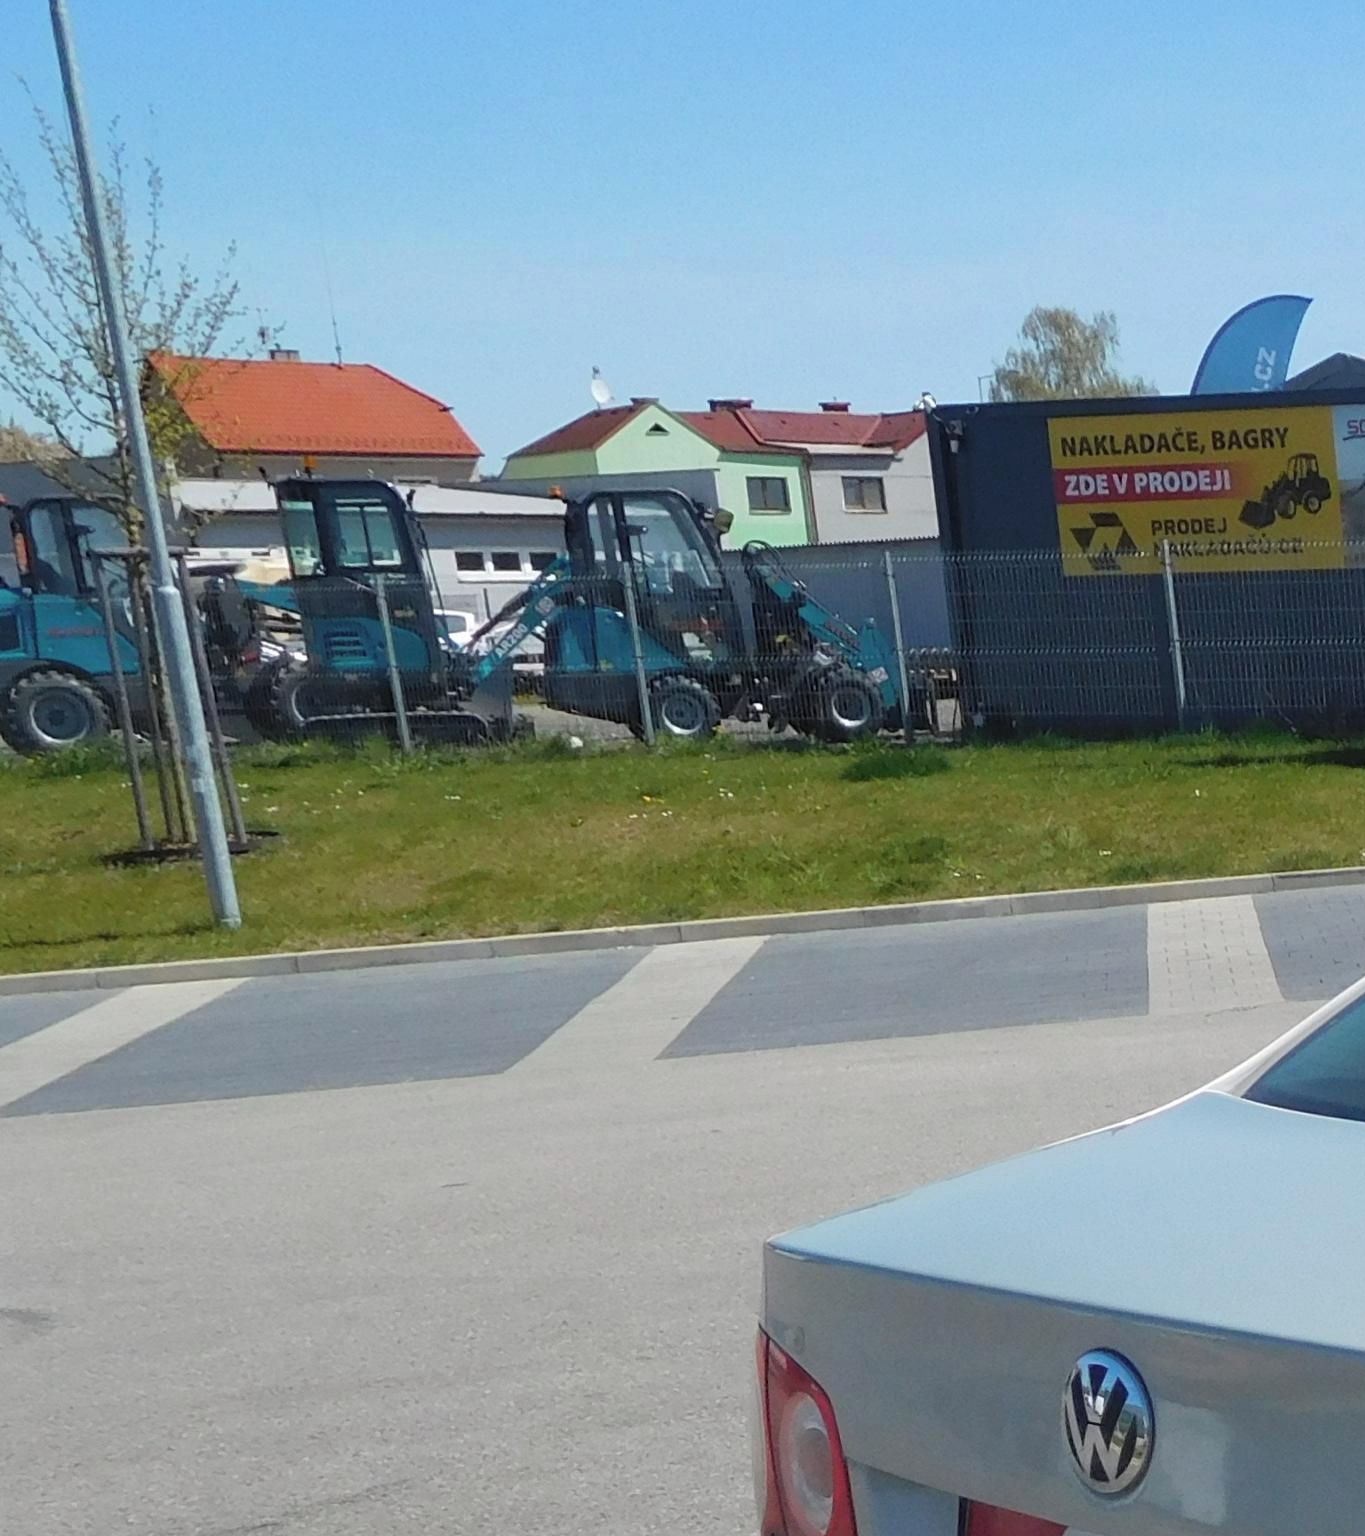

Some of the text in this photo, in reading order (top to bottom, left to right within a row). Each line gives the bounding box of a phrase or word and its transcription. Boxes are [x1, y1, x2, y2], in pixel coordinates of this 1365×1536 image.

[1061, 427, 1289, 457] NAKLADAČE, BAGRY
[1064, 470, 1232, 496] ZDE V PRODEJI
[1151, 517, 1227, 535] PRODEJ
